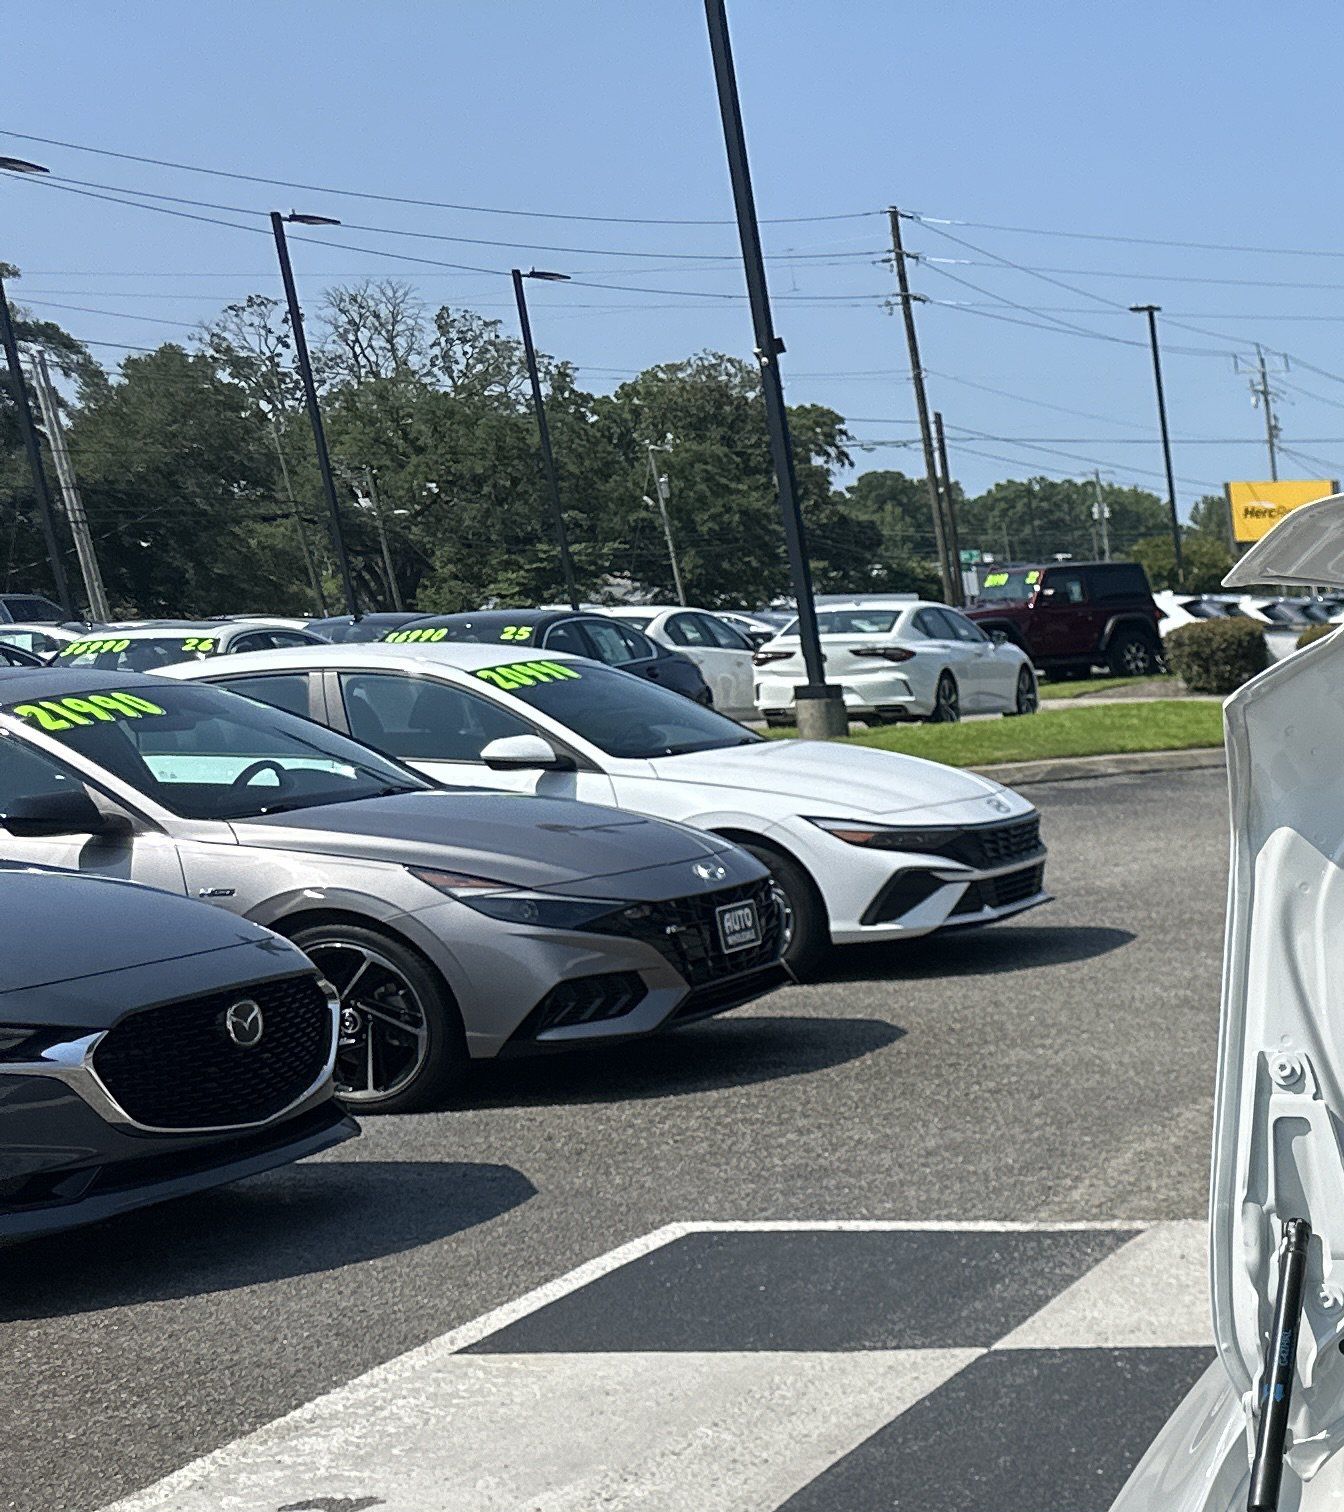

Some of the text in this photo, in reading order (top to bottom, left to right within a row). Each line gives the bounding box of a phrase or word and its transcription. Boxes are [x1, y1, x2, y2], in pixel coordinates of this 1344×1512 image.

[182, 638, 214, 651] 26
[500, 626, 533, 641] 25
[476, 660, 582, 690] 20990
[13, 692, 167, 731] 21990
[724, 907, 753, 935] AUTO
